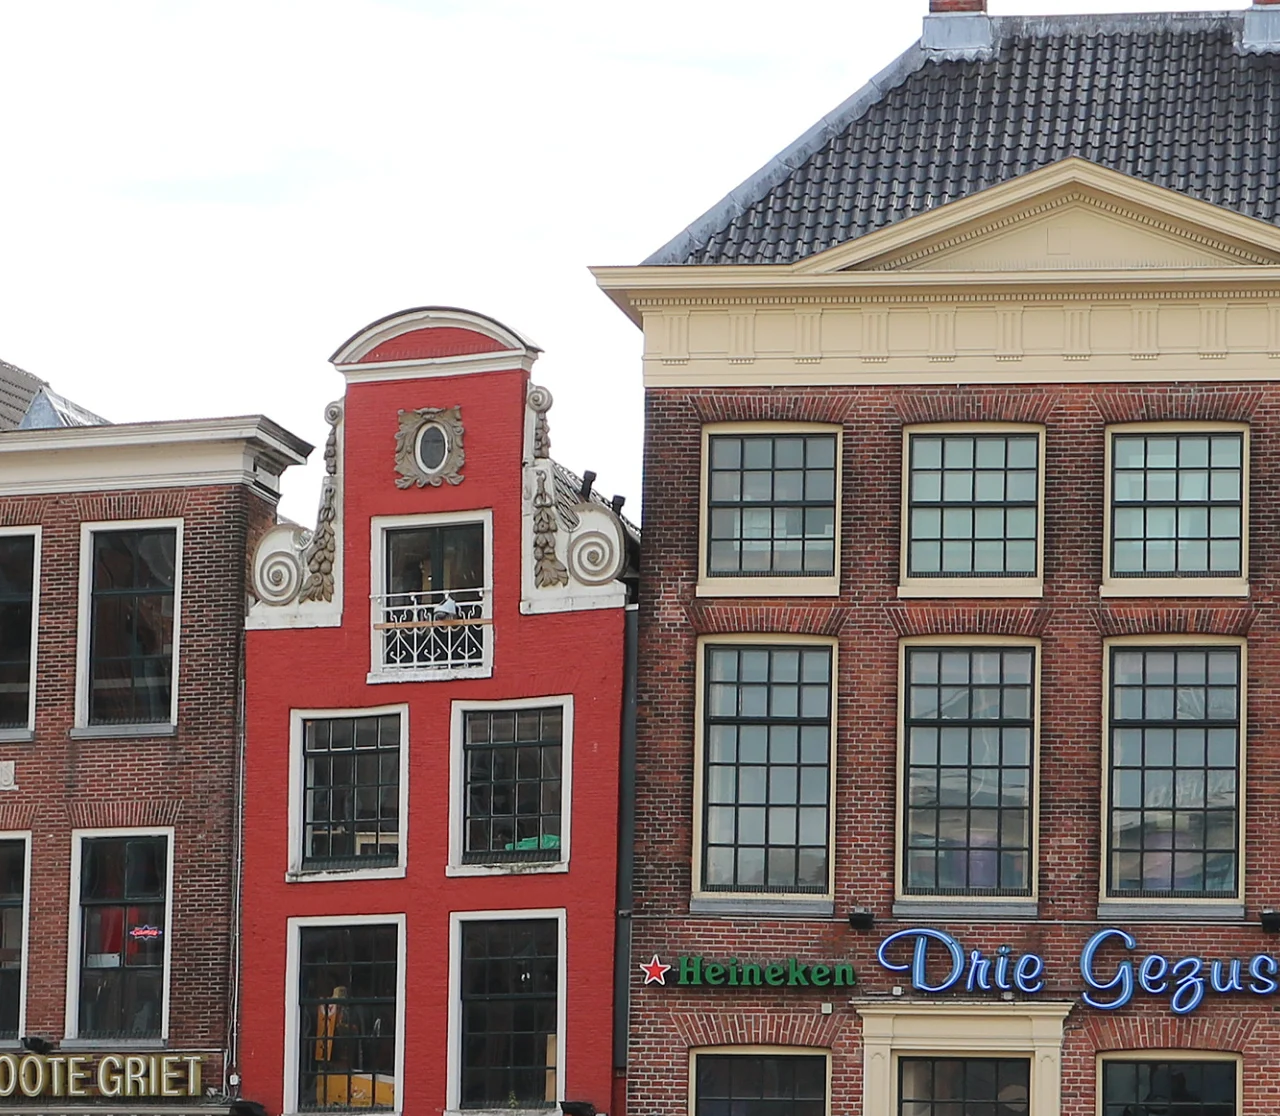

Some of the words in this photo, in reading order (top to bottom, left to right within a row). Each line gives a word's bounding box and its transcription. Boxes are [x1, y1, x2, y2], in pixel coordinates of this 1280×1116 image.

[677, 955, 856, 987] Heineken
[877, 927, 1046, 993] Drie
[97, 1053, 207, 1097] GRIET
